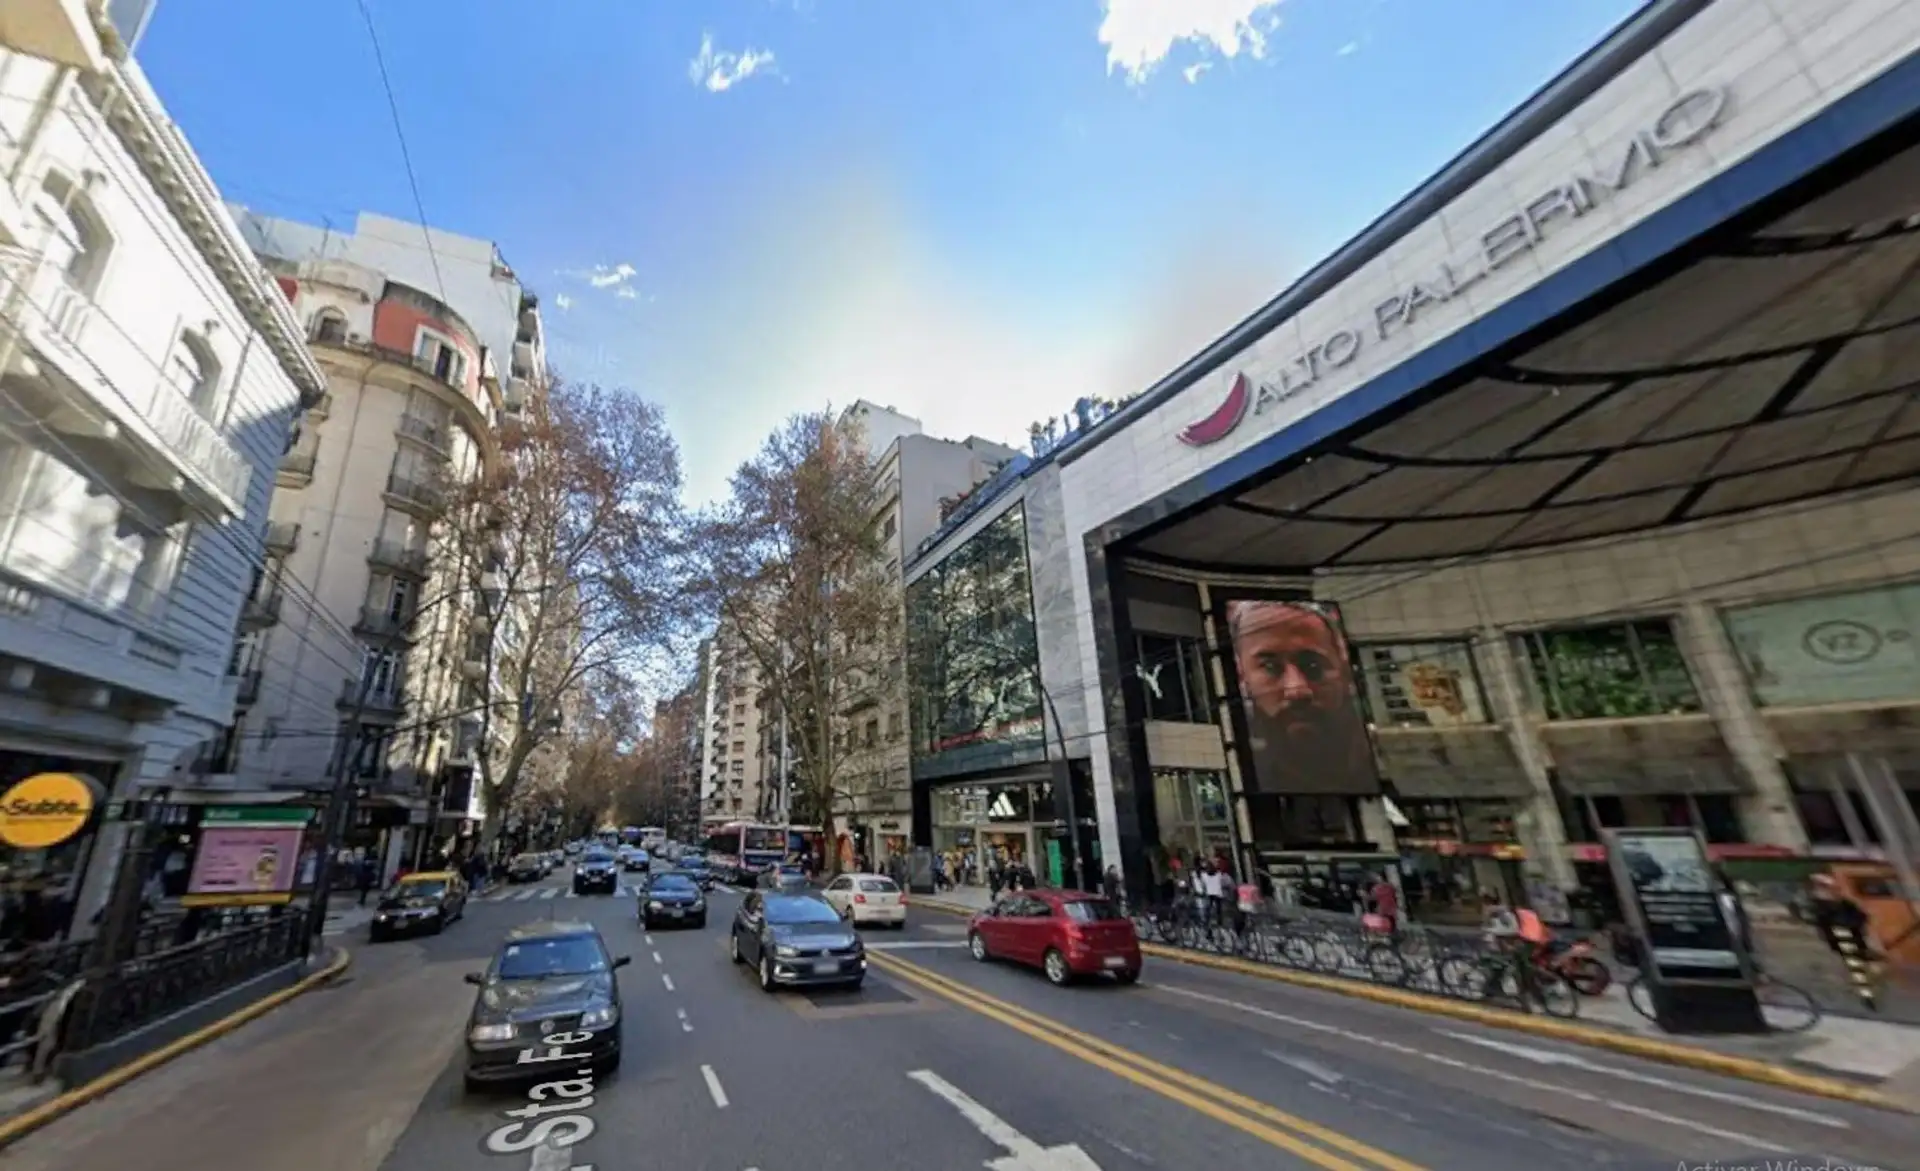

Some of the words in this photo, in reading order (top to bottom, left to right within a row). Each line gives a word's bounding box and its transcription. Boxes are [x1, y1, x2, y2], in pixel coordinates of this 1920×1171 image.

[1250, 328, 1362, 416] ALTO
[1374, 82, 1729, 341] PALERMO
[8, 798, 80, 815] Subte
